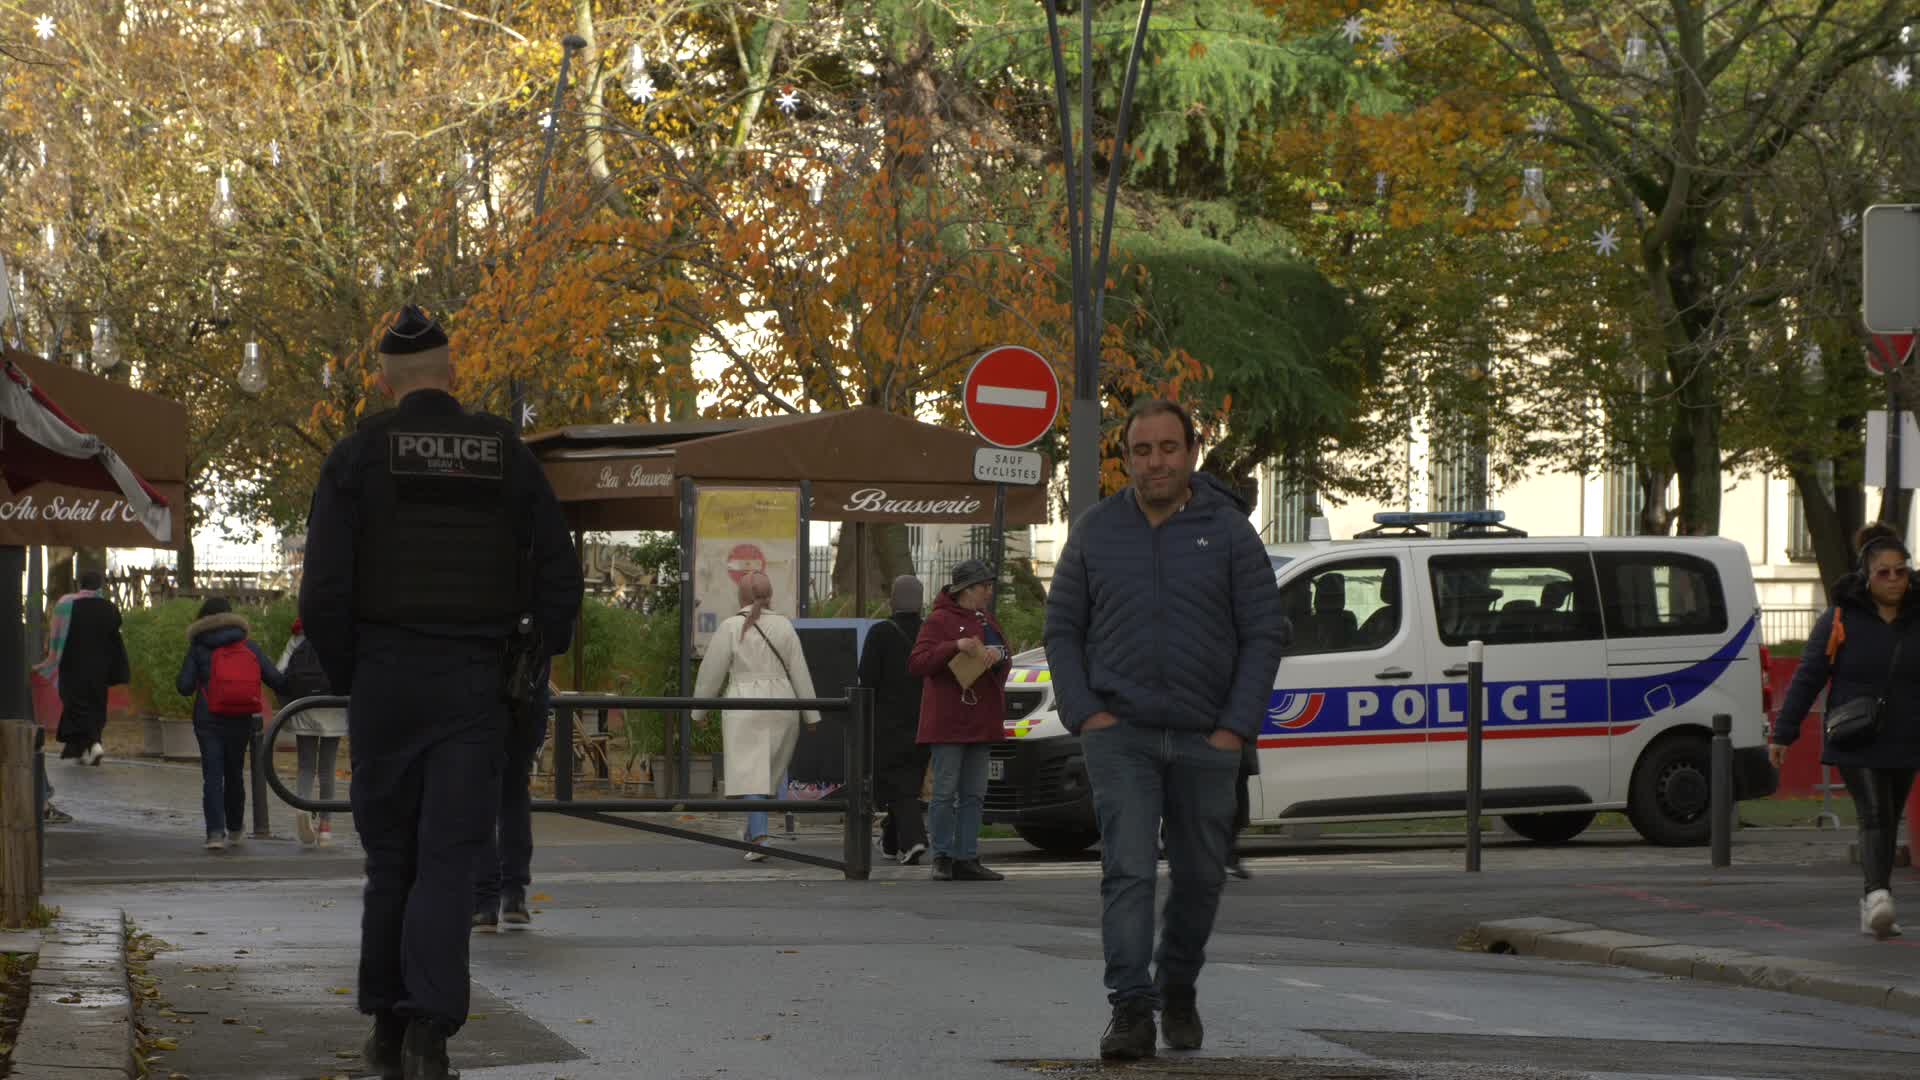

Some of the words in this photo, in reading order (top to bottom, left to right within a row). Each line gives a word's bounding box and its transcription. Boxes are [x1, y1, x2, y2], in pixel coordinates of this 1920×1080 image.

[398, 436, 497, 462] POLICE
[995, 454, 1023, 465] SAUF
[978, 465, 1037, 479] CYCLISTES
[0, 496, 39, 520] Au
[42, 496, 99, 521] Soleil
[843, 488, 980, 514] Brasserie
